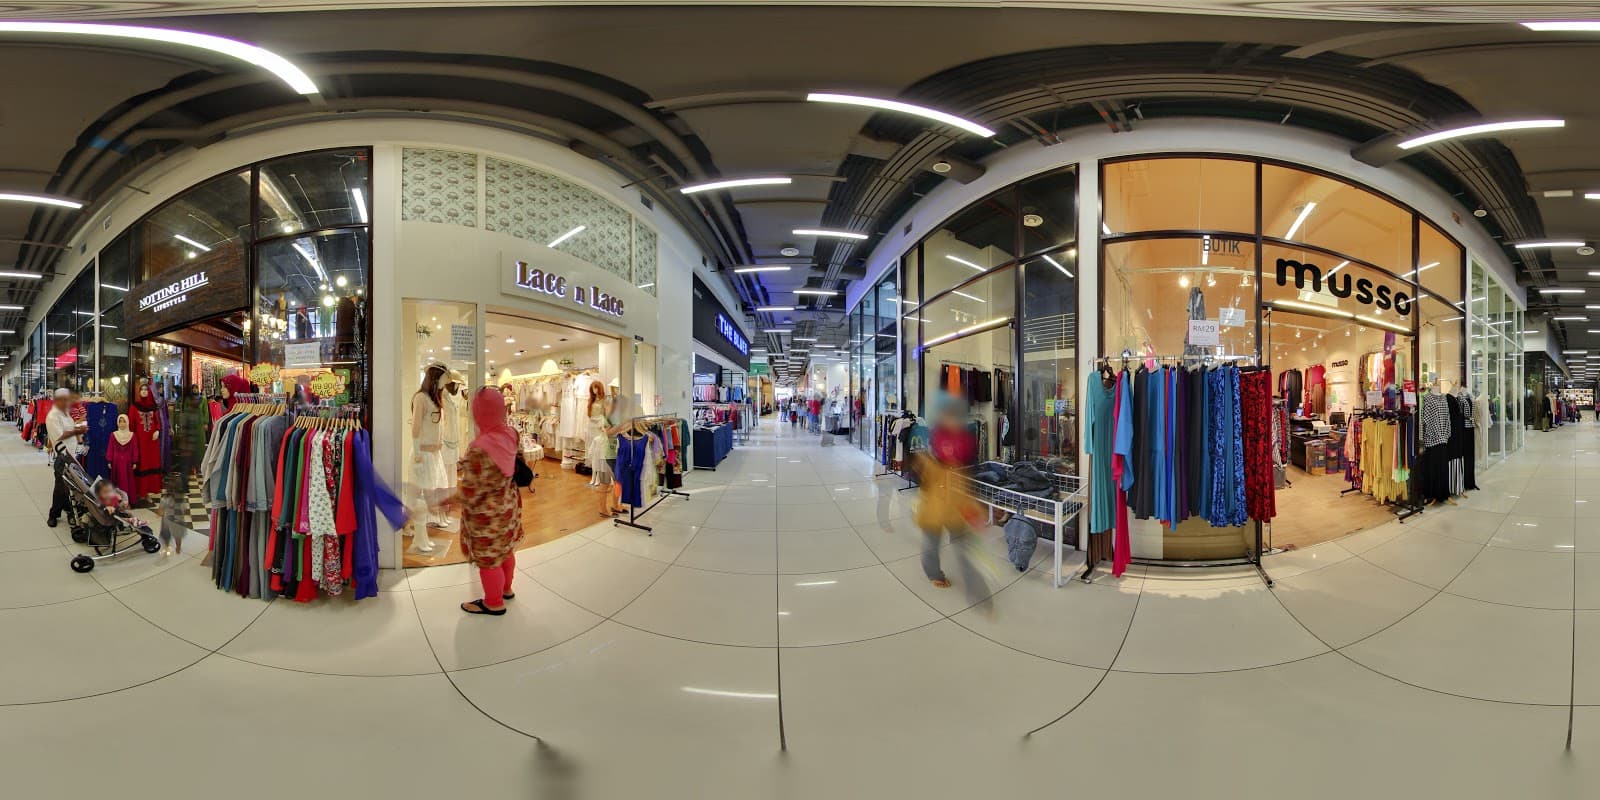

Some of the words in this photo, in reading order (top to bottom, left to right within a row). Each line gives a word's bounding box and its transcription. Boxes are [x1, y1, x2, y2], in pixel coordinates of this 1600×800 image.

[1203, 239, 1241, 254] BUTIK
[139, 282, 179, 308] NOTTING
[181, 271, 209, 290] HILL
[516, 261, 566, 297] Lace
[574, 286, 585, 304] n
[591, 286, 624, 317] Lace
[1276, 258, 1411, 315] musso
[153, 295, 187, 312] LIFESTYLE
[718, 313, 733, 342] THE
[1193, 325, 1215, 333] RM29
[1332, 359, 1349, 368] musso
